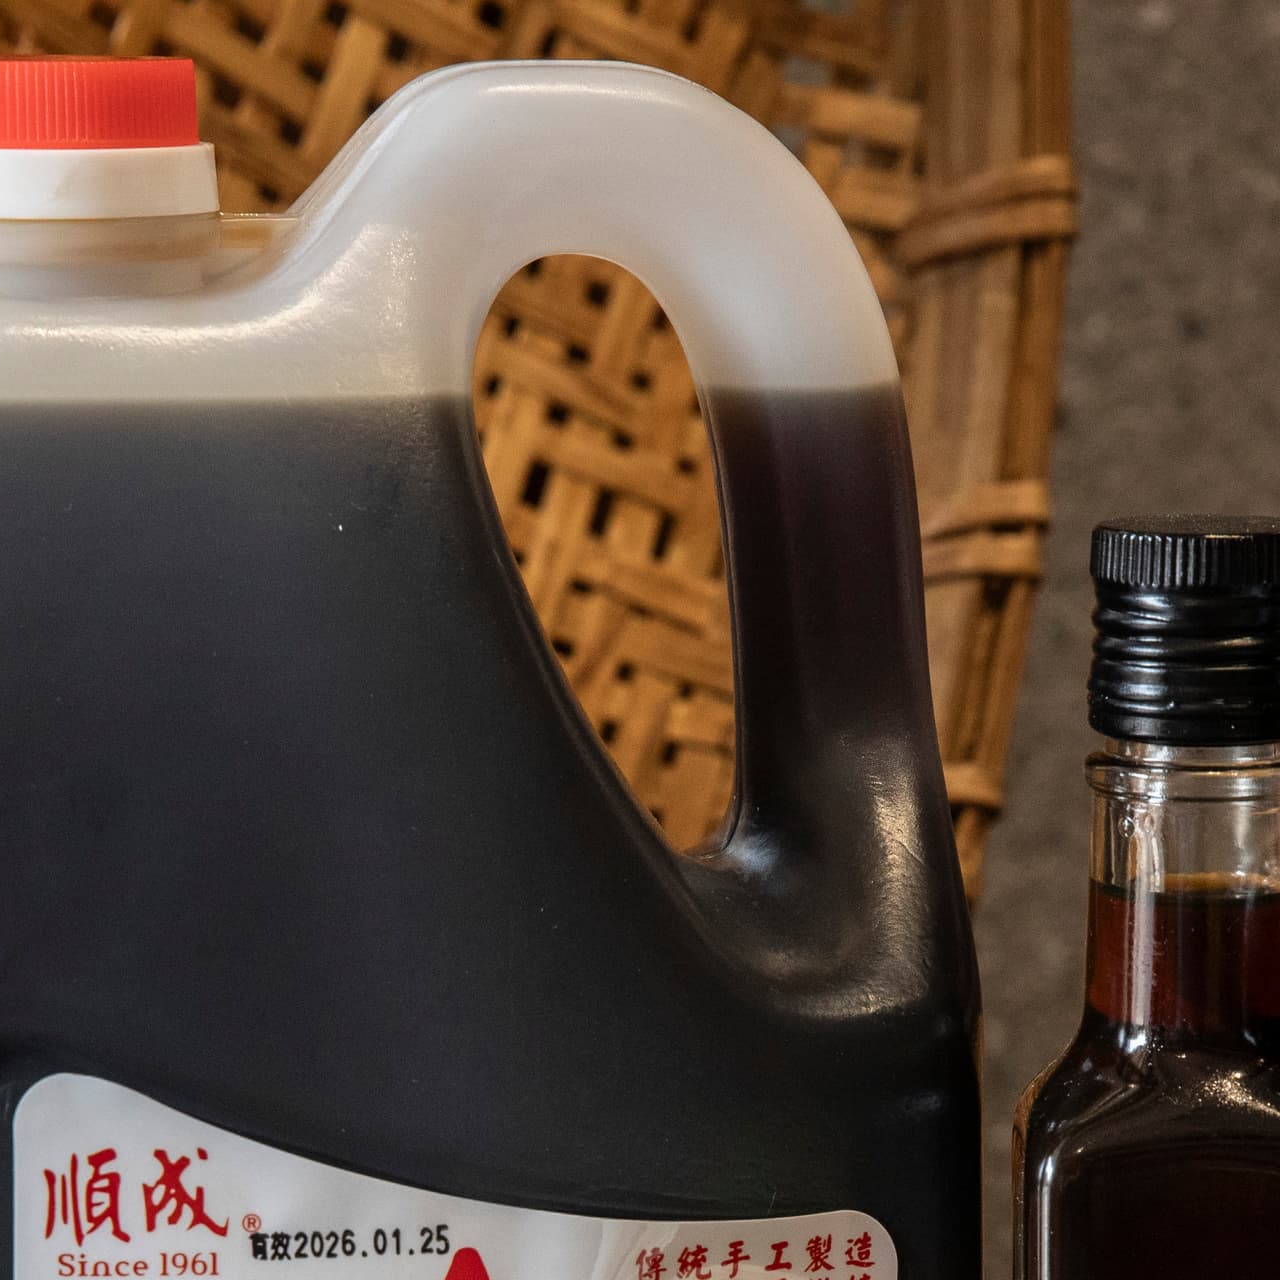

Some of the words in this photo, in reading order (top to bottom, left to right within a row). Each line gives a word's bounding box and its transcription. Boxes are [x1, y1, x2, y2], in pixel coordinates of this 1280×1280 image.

[43, 1147, 229, 1246] 順成
[58, 1251, 148, 1277] Since
[160, 1251, 220, 1276] 1961
